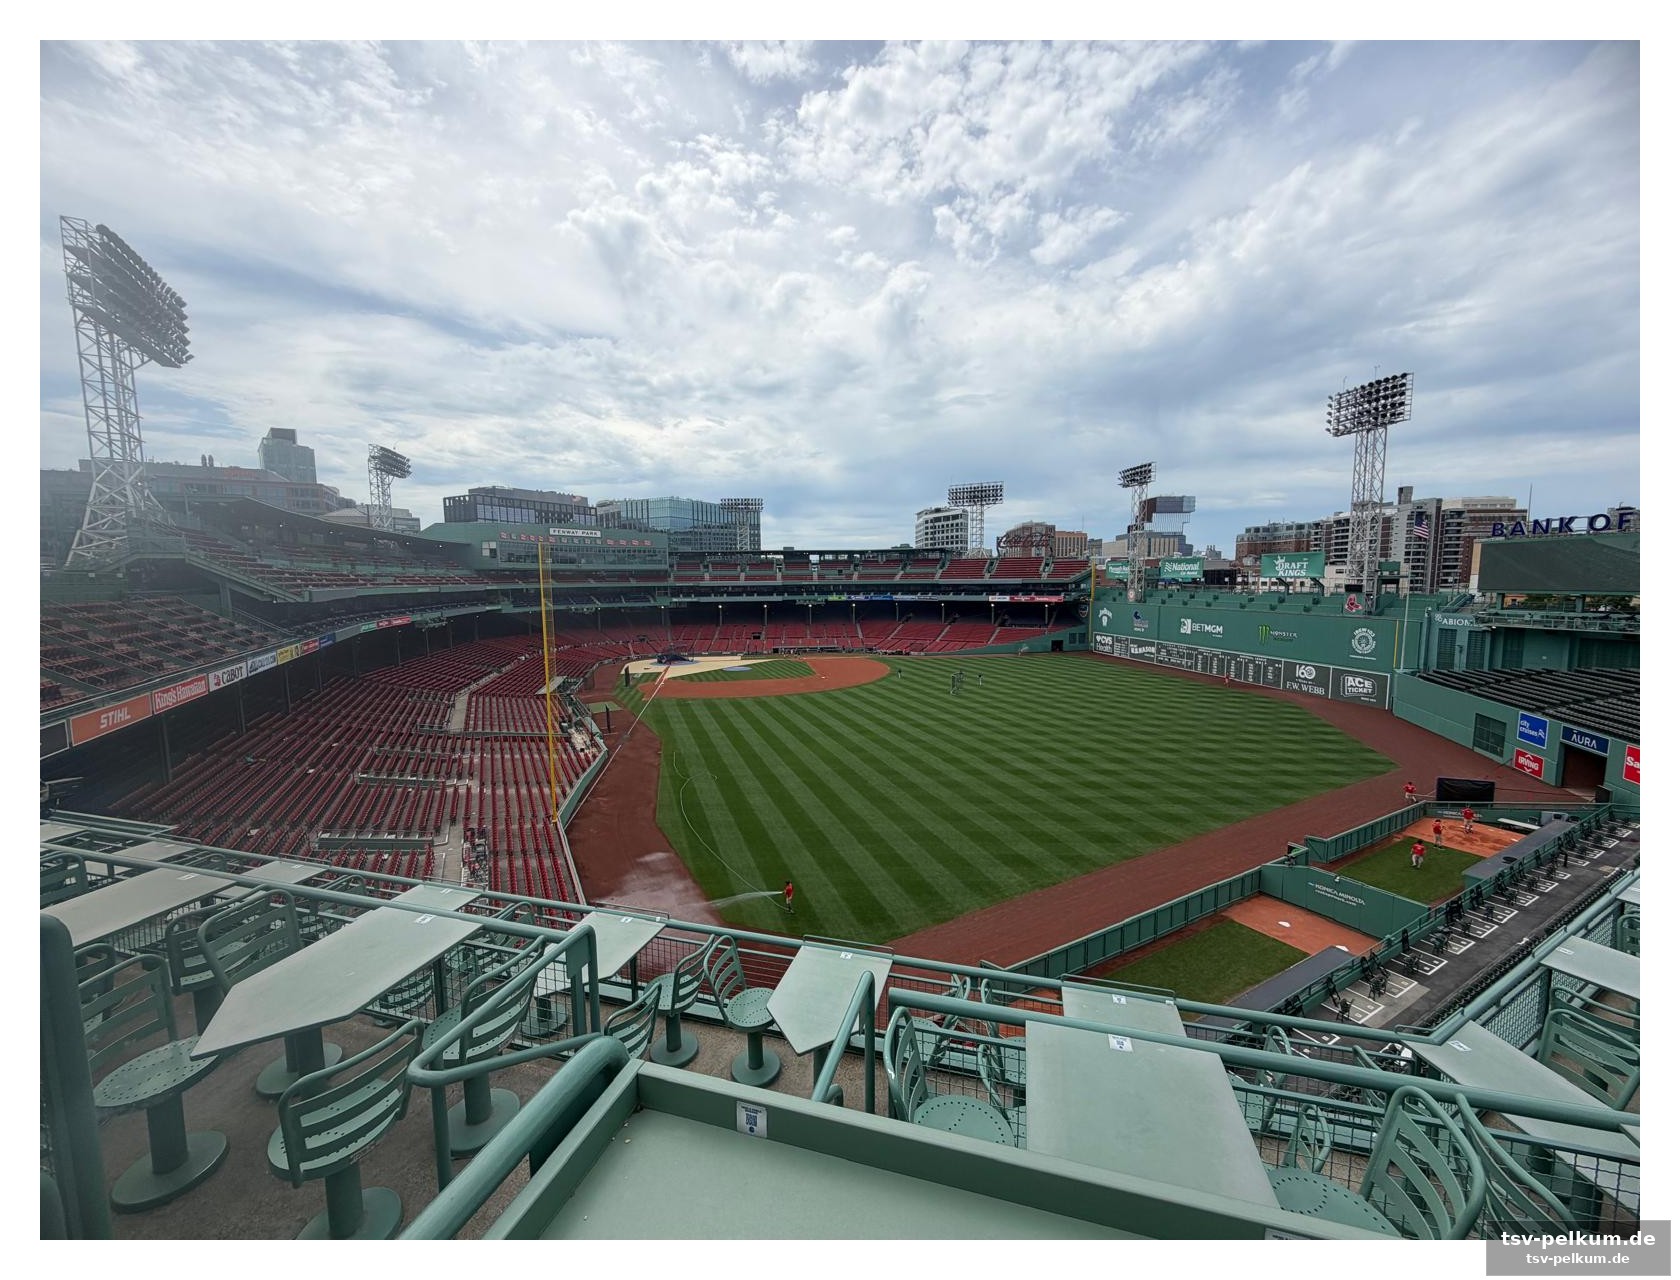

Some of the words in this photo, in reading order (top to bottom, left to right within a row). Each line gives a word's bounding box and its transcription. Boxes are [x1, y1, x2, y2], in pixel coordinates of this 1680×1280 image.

[1491, 515, 1577, 538] BANK
[1588, 511, 1635, 532] OF
[1172, 562, 1200, 571] National
[1276, 560, 1309, 571] DRAFT
[1277, 569, 1307, 577] KINGS
[1192, 622, 1223, 635] BETMGM
[1101, 635, 1113, 645] CVS
[1096, 642, 1113, 653] Health
[1296, 664, 1316, 680] 160
[1347, 676, 1373, 688] ACE
[1301, 683, 1325, 695] WEBB
[155, 689, 177, 709] King's
[99, 707, 132, 729] STIHL
[1520, 719, 1530, 728] city
[1518, 756, 1539, 771] IRVING
[1338, 892, 1366, 905] MINOLTA
